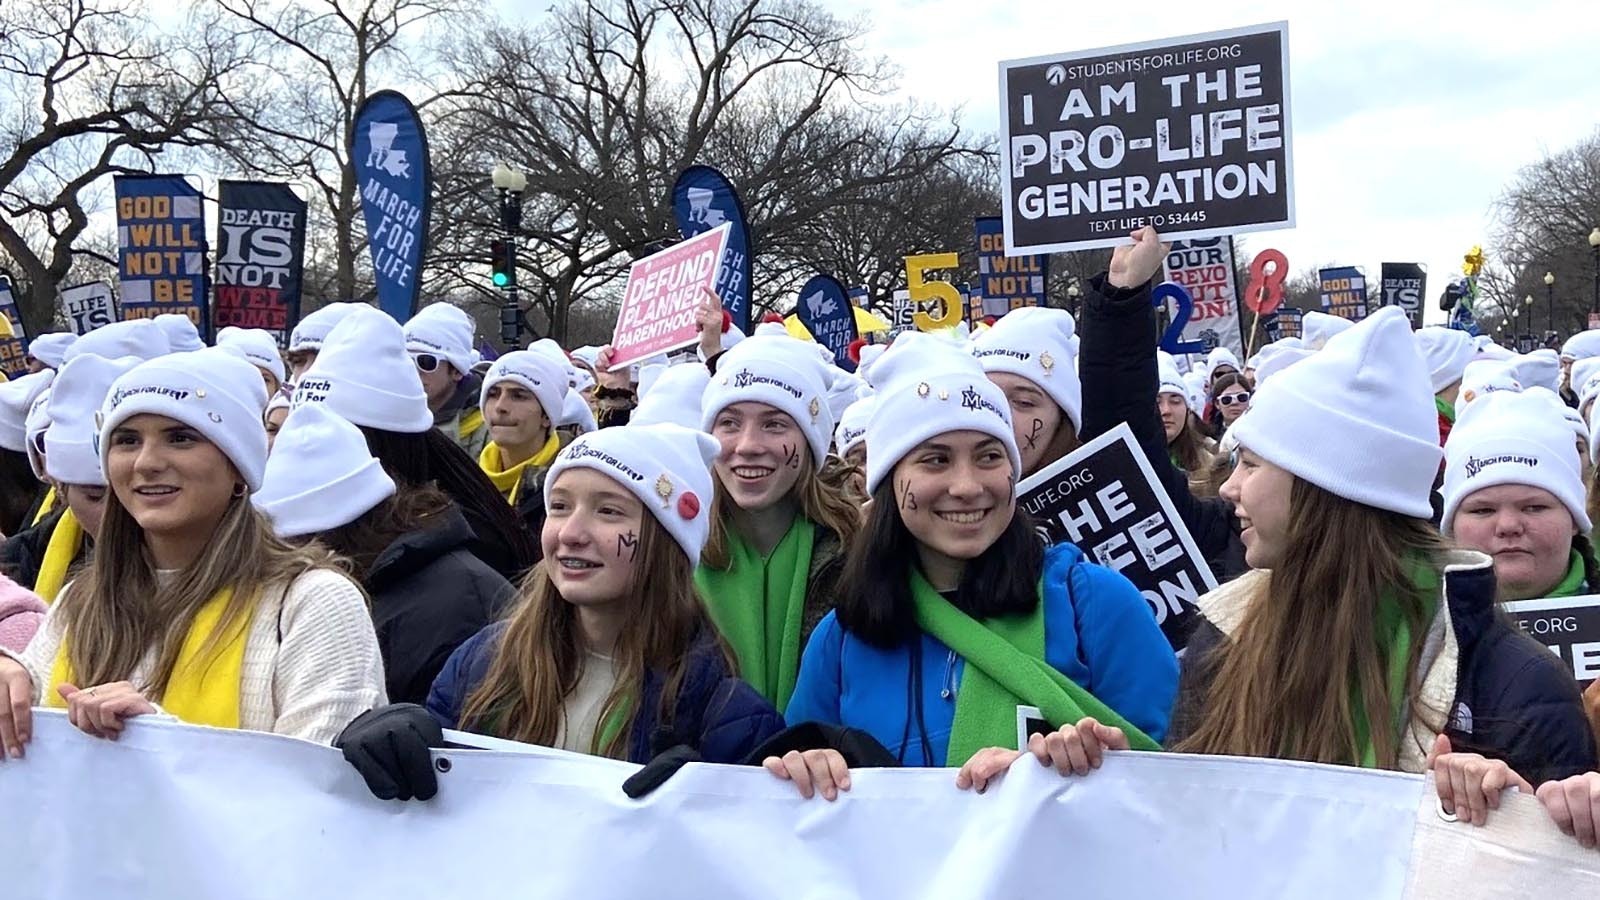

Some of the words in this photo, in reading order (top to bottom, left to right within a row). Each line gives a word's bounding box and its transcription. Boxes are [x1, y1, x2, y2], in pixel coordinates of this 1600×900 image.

[1068, 44, 1241, 79] STUDENTSFORLIFE.ORG
[1023, 94, 1034, 125] I
[1059, 81, 1136, 121] AM
[1162, 64, 1262, 108] THE
[1011, 104, 1282, 178] PRO-LIFE
[1018, 160, 1276, 220] GENERATION
[119, 195, 170, 219] GOD
[363, 178, 420, 230] MARCH
[222, 208, 296, 229] DEATH
[1088, 220, 1117, 232] TEXT
[1120, 216, 1145, 230] LIFE
[1147, 215, 1165, 227] TO
[1167, 210, 1206, 224] 53445
[130, 224, 198, 247] WILL
[218, 225, 293, 266] IS
[373, 216, 415, 259] FOR
[126, 252, 181, 275] NOT
[374, 247, 412, 287] LIFE
[991, 255, 1040, 273] WILL
[1167, 248, 1225, 270] OUR
[217, 264, 290, 289] NOT
[628, 250, 715, 308] DEFUND
[988, 276, 1029, 295] NOT
[1244, 248, 1289, 315] 8
[1322, 278, 1349, 291] GOD
[1384, 278, 1421, 288] DEATH
[154, 279, 193, 302] BE
[904, 252, 963, 332] 5
[1385, 288, 1419, 310] IS
[69, 295, 107, 314] LIFE
[71, 309, 110, 336] IS
[1151, 280, 1219, 355] 2
[830, 330, 850, 349] FOR
[600, 453, 618, 466] FOR
[1022, 467, 1095, 515] LIFE.ORG
[1057, 480, 1137, 544] HE
